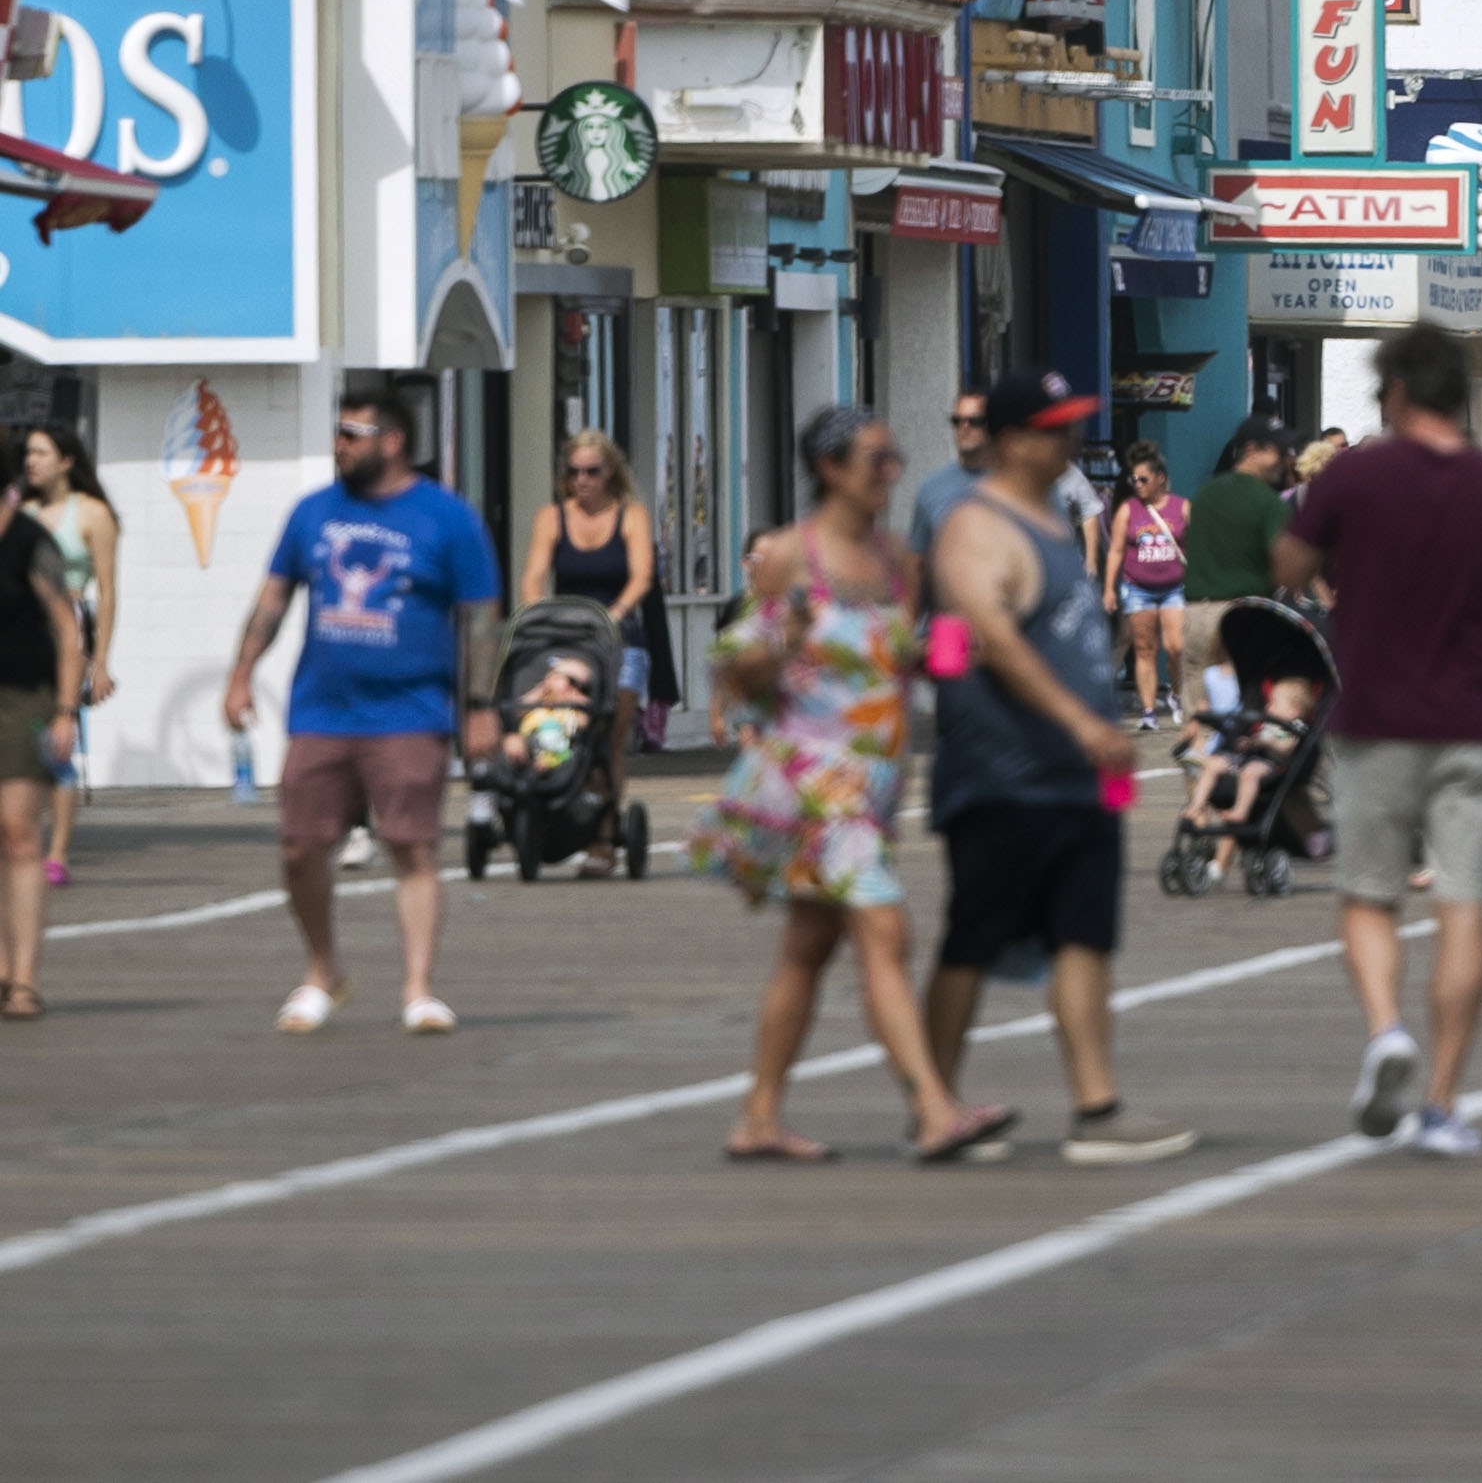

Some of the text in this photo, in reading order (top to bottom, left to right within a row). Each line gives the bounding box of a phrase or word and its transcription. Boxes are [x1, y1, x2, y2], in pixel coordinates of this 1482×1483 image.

[1310, 0, 1362, 132] FUN
[1288, 195, 1402, 221] ATM
[1308, 278, 1356, 293] OPEN
[1272, 294, 1394, 310] YEAR ROUND
